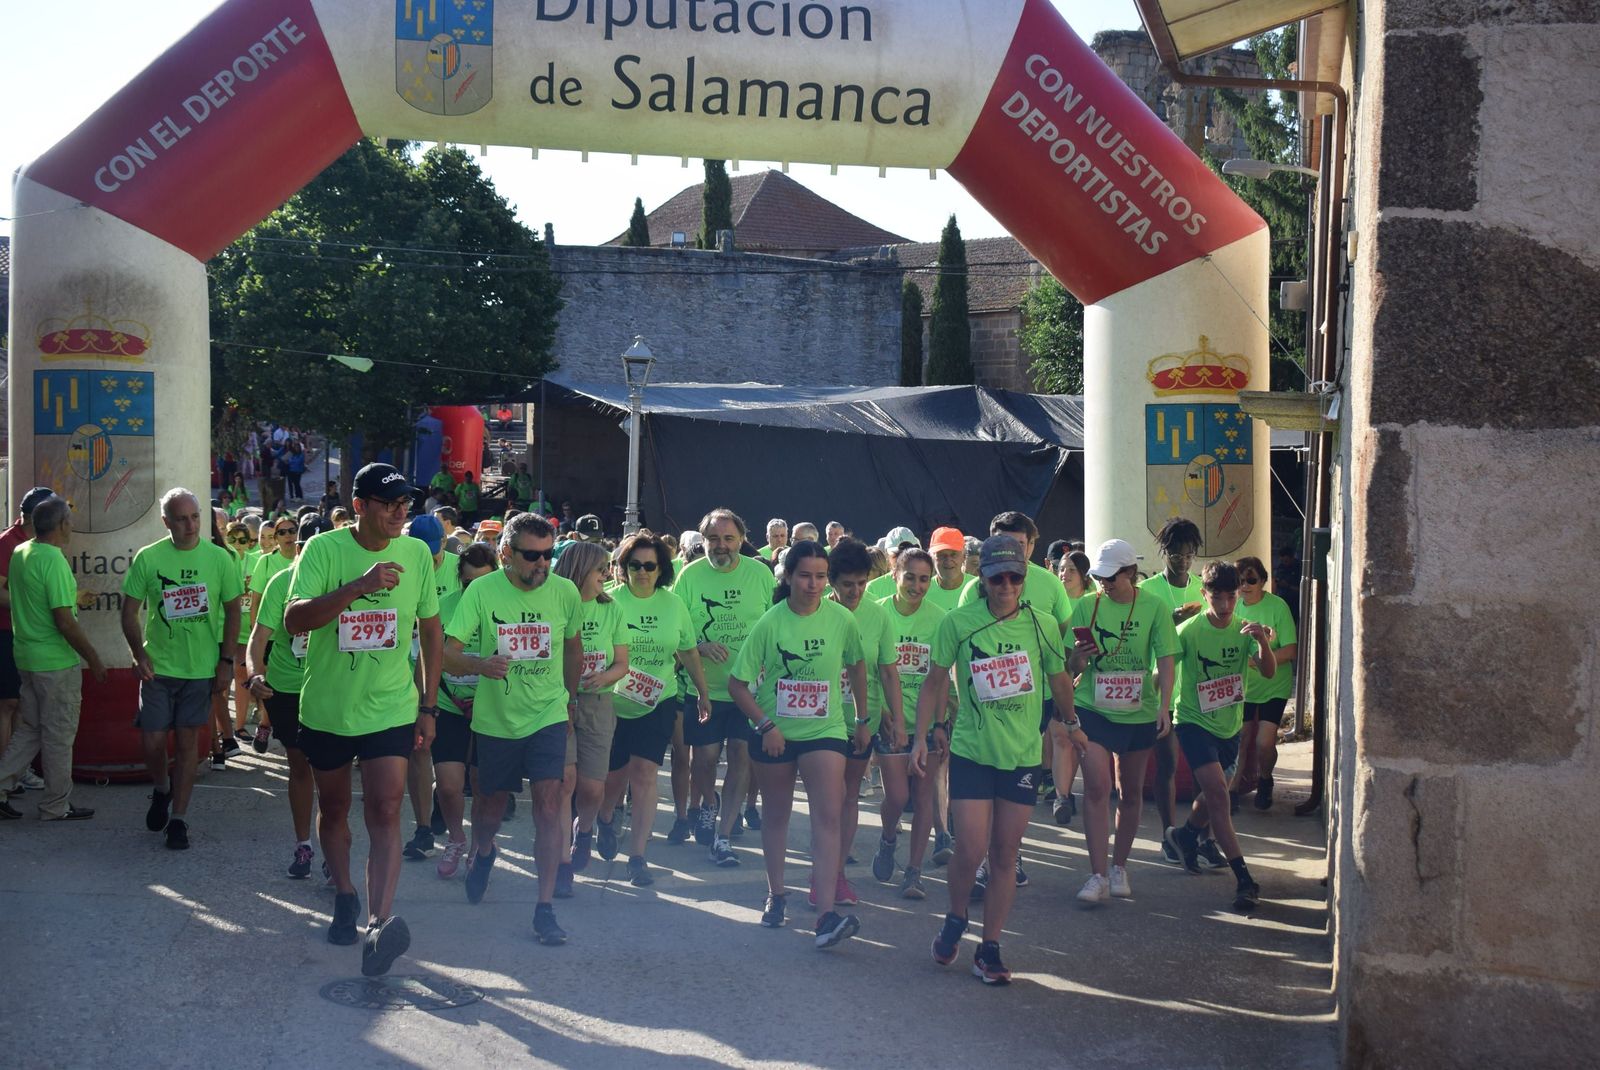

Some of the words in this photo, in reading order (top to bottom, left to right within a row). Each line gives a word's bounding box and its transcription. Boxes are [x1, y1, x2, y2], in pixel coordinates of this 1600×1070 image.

[529, 62, 583, 106] de
[611, 54, 931, 126] Salamanca
[94, 138, 157, 192] CON
[149, 116, 191, 149] EL
[182, 17, 306, 123] DEPORTE
[1025, 54, 1083, 112] CON
[1076, 105, 1206, 235] NUESTROS
[1001, 91, 1168, 254] DEPORTISTAS
[382, 473, 405, 484] adid
[174, 595, 200, 610] 225
[340, 612, 396, 625] bedunia
[351, 623, 386, 641] 299
[499, 625, 550, 636] bedunia
[509, 636, 540, 651] 318
[628, 644, 664, 654] ASTELLANA
[896, 653, 920, 666] 285
[971, 655, 1028, 674] bedunia
[629, 670, 664, 690] edunia
[986, 668, 1021, 689] 125
[625, 679, 653, 698] 298
[779, 682, 828, 693] bedunia
[1105, 686, 1133, 699] 222
[1208, 685, 1235, 702] 288
[787, 693, 818, 708] 263
